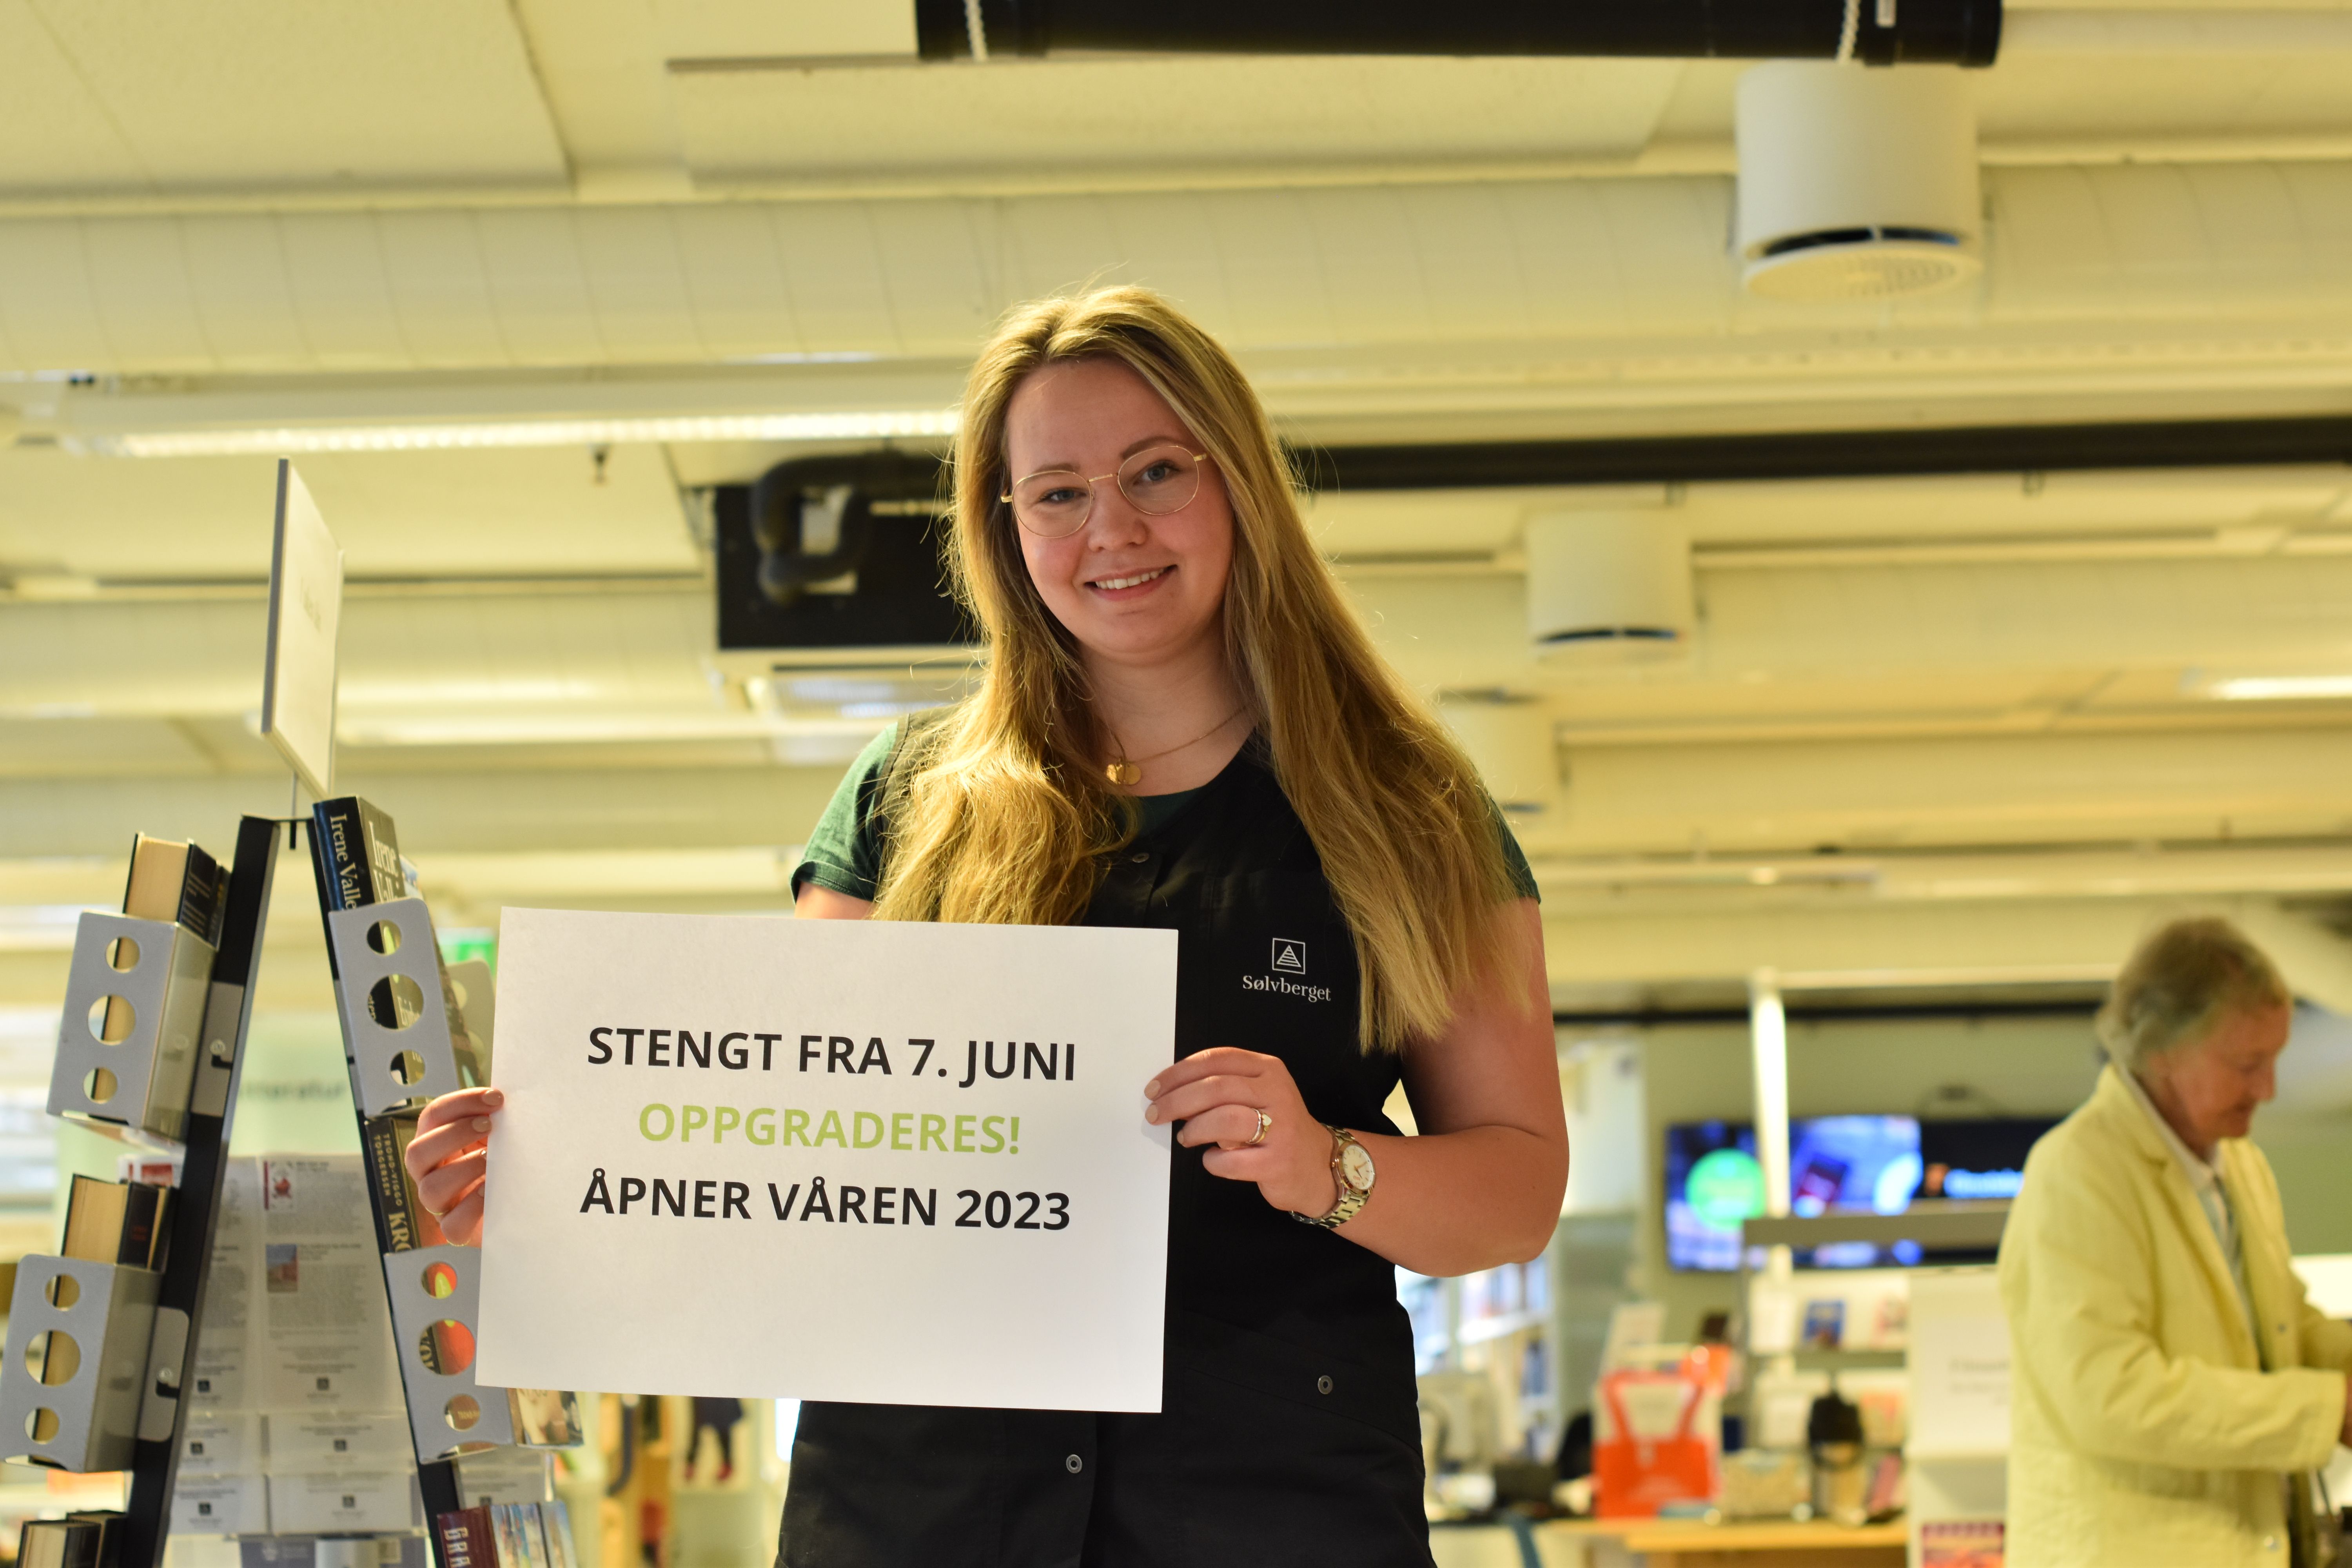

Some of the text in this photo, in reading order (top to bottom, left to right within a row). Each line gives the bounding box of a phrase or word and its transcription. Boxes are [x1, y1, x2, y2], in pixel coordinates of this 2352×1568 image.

[330, 813, 348, 862] Irene
[368, 821, 399, 877] Irene
[1242, 975, 1331, 1003] Sølvberget
[588, 1027, 1075, 1089] STENGT FRA 7. JUNI
[639, 1103, 1020, 1155] OPPGRADERES!
[579, 1167, 1070, 1231] ÅPNER VÅREN 2023
